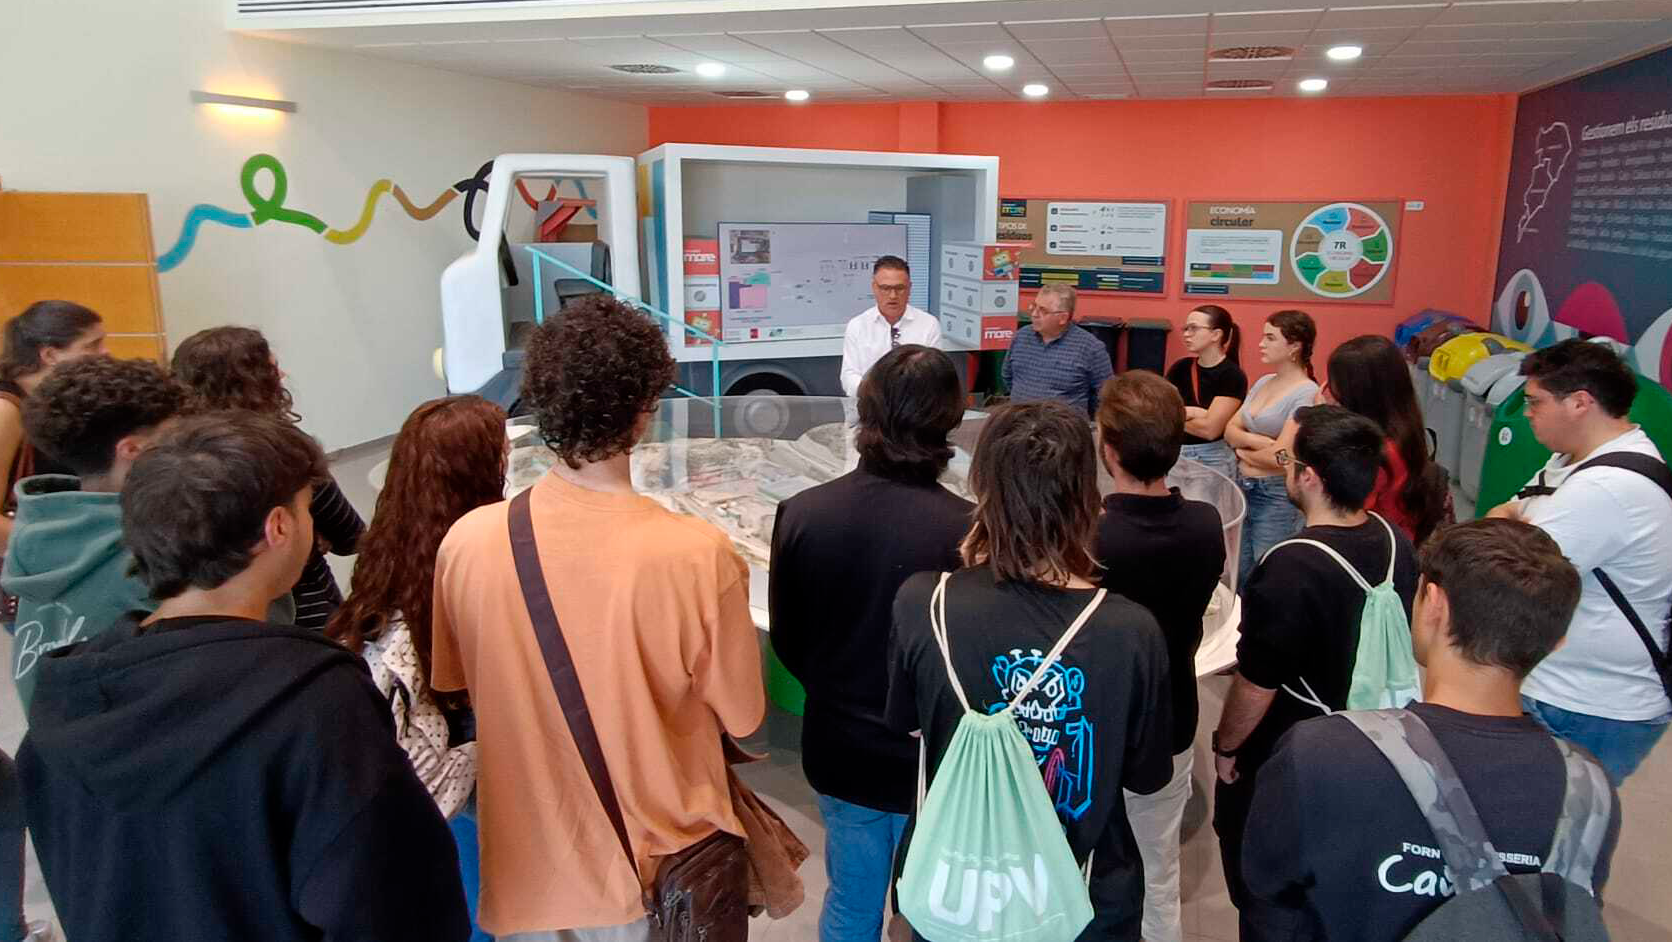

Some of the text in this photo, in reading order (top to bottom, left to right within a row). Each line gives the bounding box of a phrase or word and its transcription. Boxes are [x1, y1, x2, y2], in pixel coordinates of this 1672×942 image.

[1333, 241, 1347, 250] 7R
[684, 253, 715, 262] more
[984, 330, 1015, 339] more
[1402, 842, 1541, 867] FORN SSERIA
[927, 853, 1048, 931] UPV
